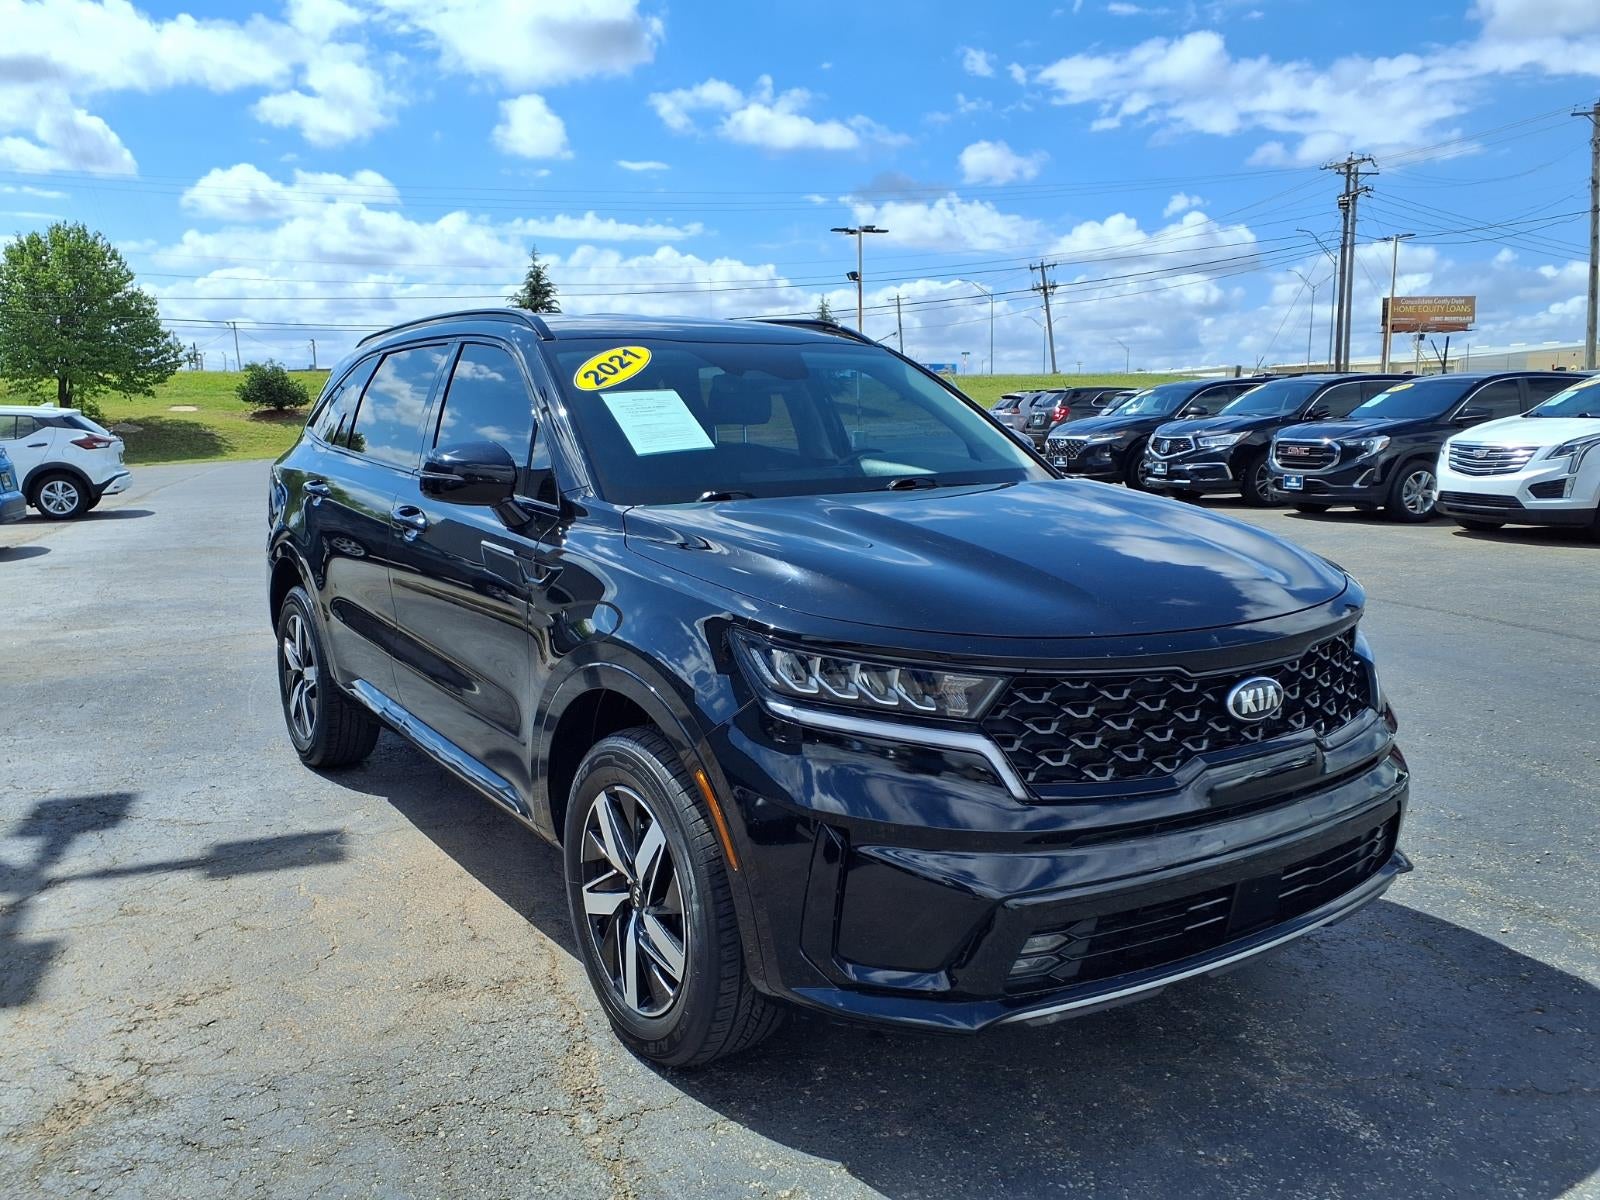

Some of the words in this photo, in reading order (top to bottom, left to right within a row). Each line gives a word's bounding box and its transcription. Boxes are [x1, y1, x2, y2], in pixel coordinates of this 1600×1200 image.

[1393, 305, 1417, 313] HOME
[1417, 305, 1445, 313] EQUITY
[1446, 305, 1471, 313] LOANS
[583, 348, 641, 386] 2021
[1287, 446, 1310, 456] GMC
[1239, 685, 1278, 714] KIA
